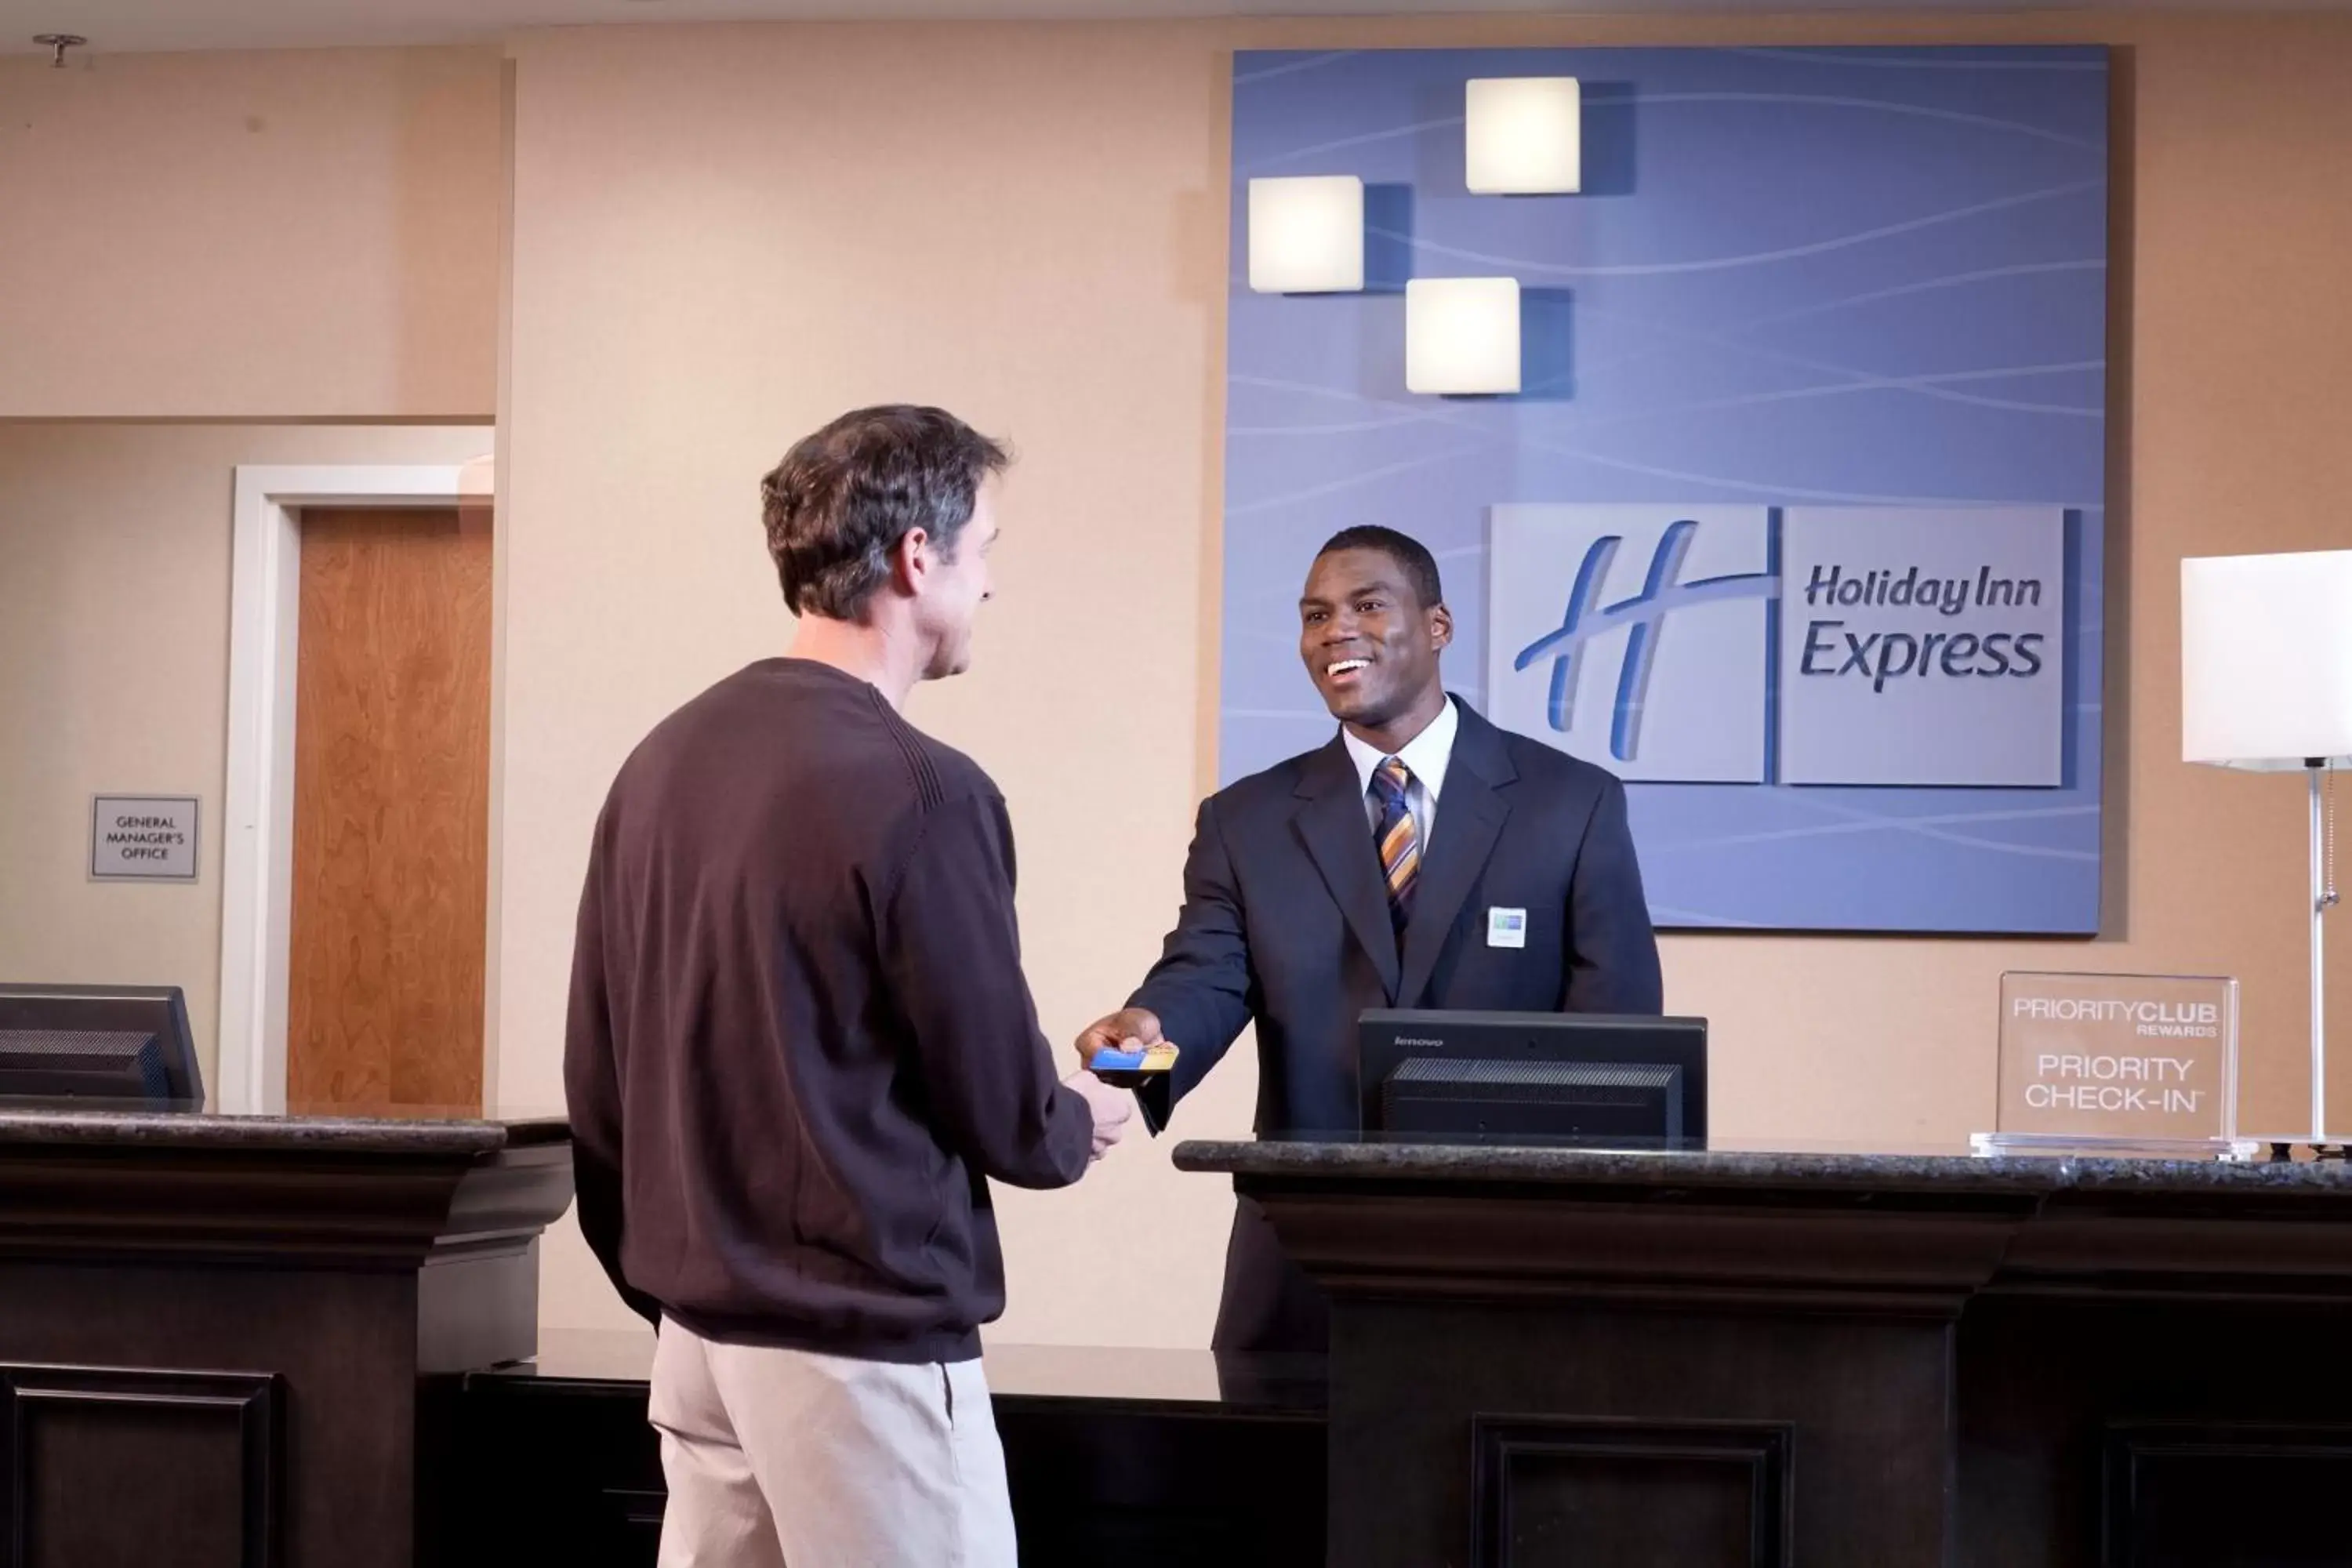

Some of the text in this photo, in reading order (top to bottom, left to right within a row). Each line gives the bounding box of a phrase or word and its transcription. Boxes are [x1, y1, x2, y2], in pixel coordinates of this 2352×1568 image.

[1805, 565, 2042, 615] Holiday Inn
[1800, 620, 2044, 693] Express
[116, 815, 176, 829] GENERAL
[106, 832, 184, 845] MANAGER'S
[121, 847, 169, 860] OFFICE
[2136, 1024, 2218, 1037] REWARDS
[1395, 1035, 1443, 1047] lenovo
[2038, 1054, 2195, 1081] PRIORITY
